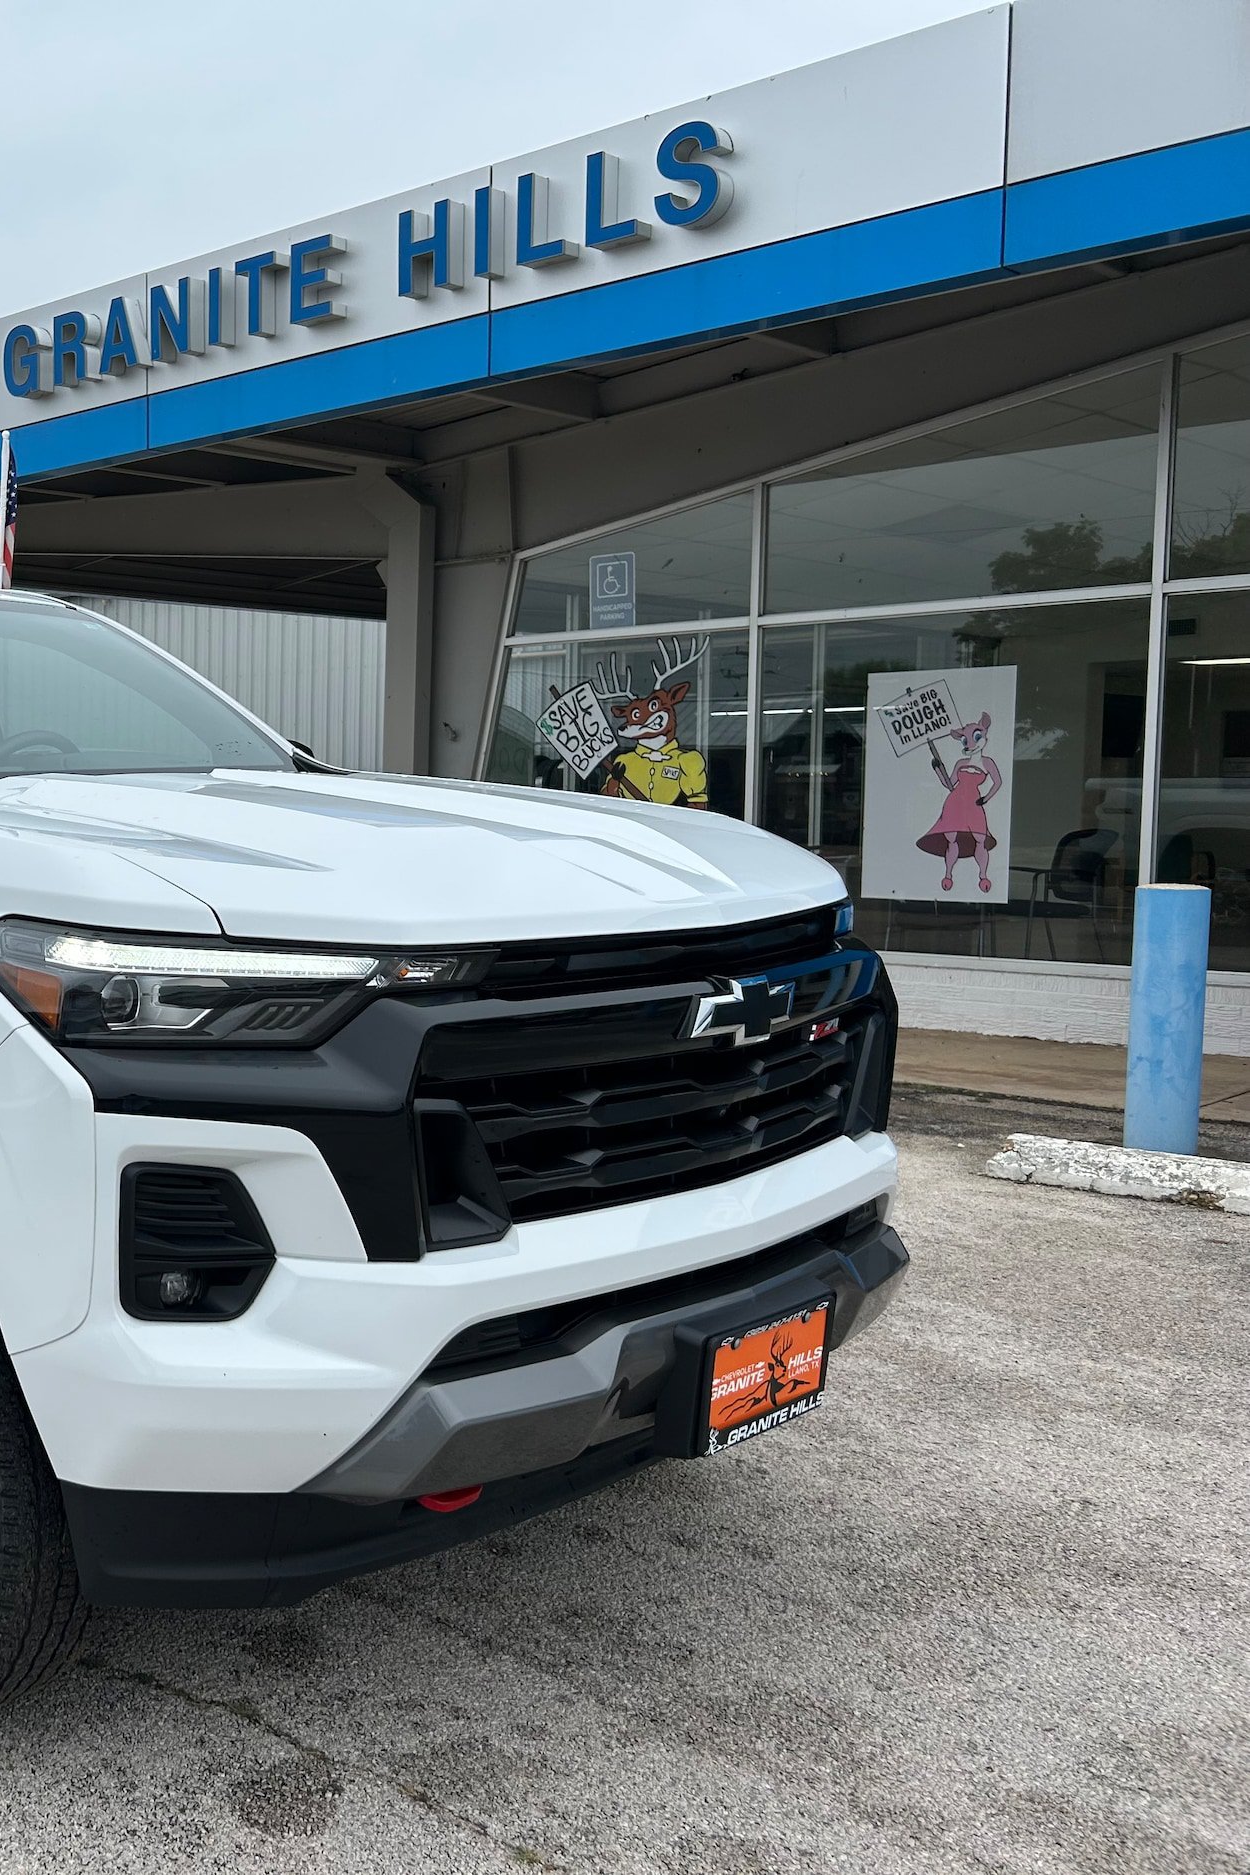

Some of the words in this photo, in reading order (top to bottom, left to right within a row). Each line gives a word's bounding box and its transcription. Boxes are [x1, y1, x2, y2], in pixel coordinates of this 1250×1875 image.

[3, 233, 347, 400] GRANITE
[398, 120, 735, 300] HILLS
[592, 602, 633, 613] HANDICAPPED
[599, 612, 625, 621] PARKING
[919, 689, 938, 704] BIG
[891, 698, 947, 735] DOUGH
[911, 714, 952, 739] LLANO!
[556, 710, 600, 753] BIG
[572, 726, 614, 771] BUCKS
[787, 1345, 823, 1370] HILLS
[811, 1360, 820, 1370] TX
[711, 1368, 766, 1402] GRANITE
[721, 1363, 756, 1383] CHEVROLET
[726, 1407, 789, 1446] GRANITE
[788, 1390, 826, 1420] HILLS
